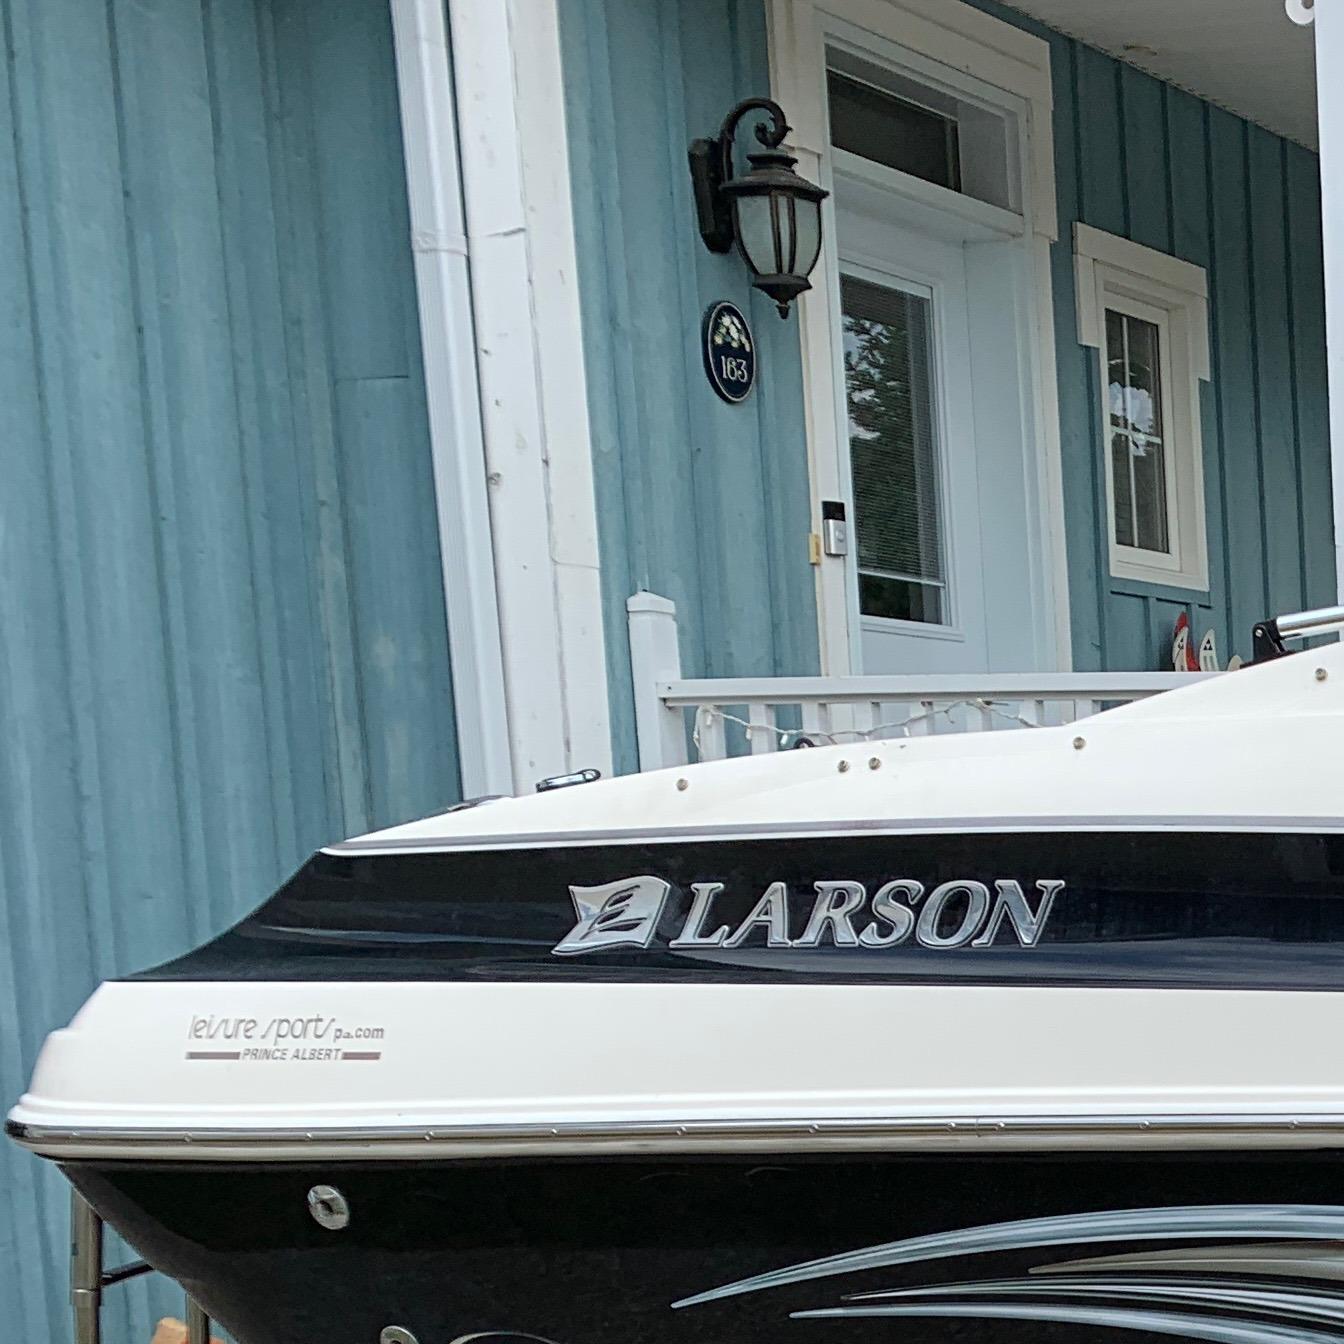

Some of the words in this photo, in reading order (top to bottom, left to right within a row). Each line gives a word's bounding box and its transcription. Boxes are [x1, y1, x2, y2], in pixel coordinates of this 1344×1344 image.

[720, 355, 748, 383] 163
[668, 878, 1066, 949] LARSON
[188, 1013, 258, 1040] leisure
[242, 1047, 288, 1061] PRINCE
[290, 1047, 342, 1061] ALBERT
